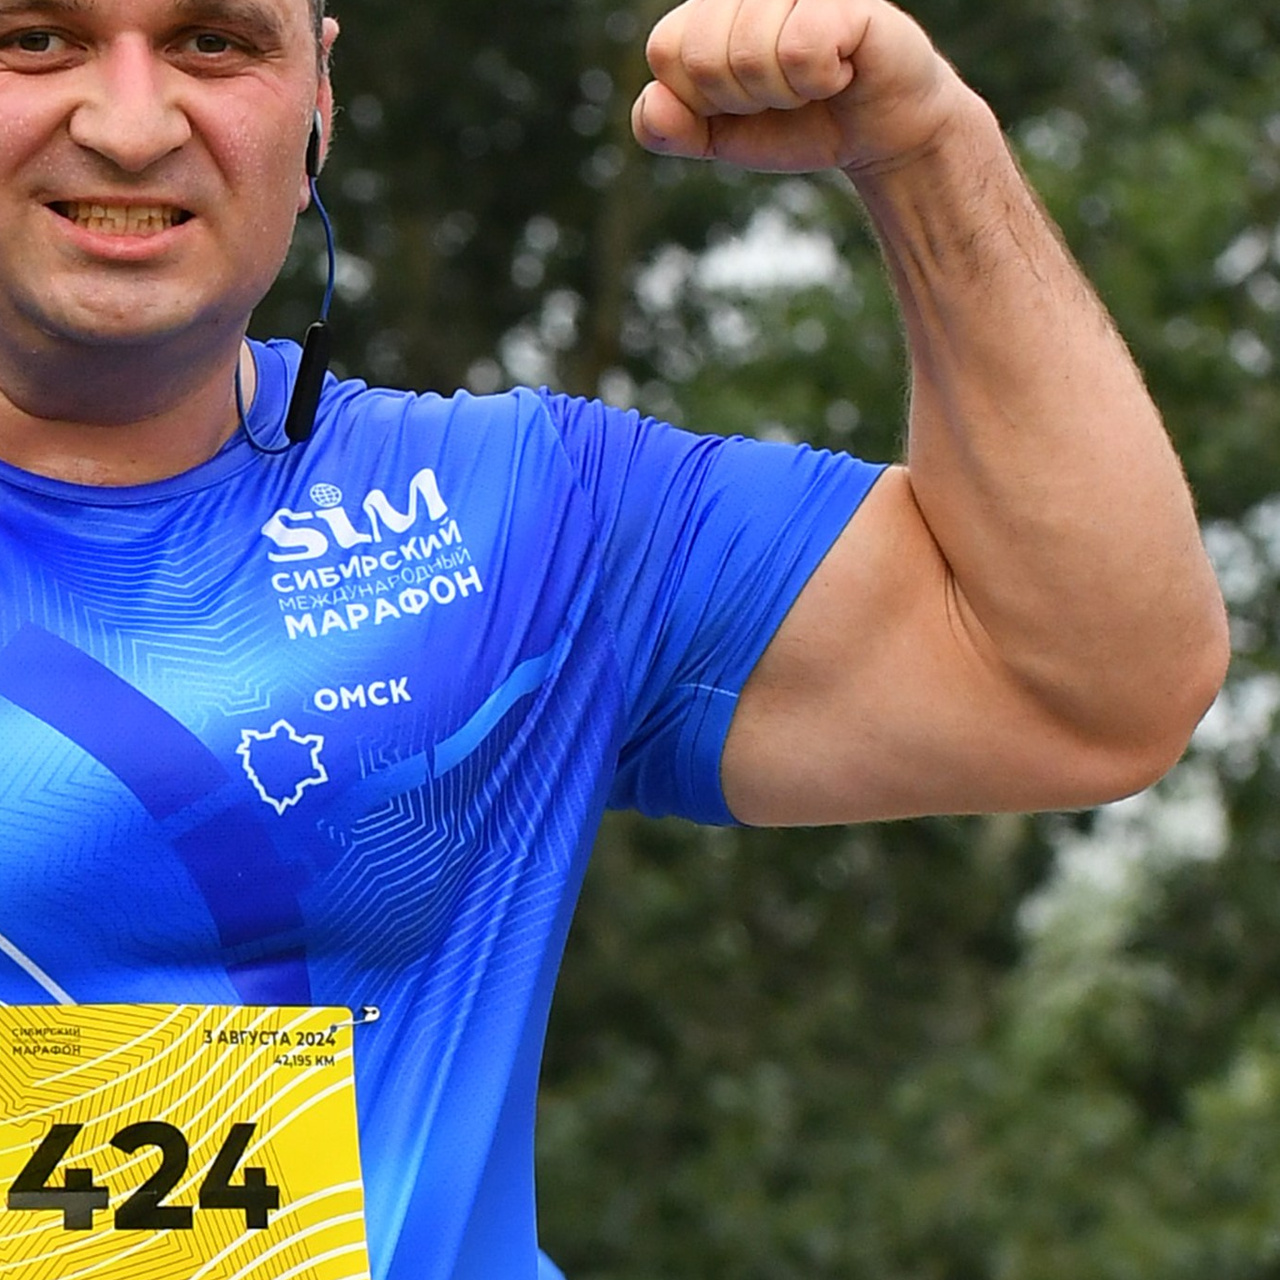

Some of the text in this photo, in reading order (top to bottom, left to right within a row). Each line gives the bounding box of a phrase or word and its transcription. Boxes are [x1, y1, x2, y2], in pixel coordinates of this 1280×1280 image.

[271, 517, 462, 593] СИБИРСКИЙ
[278, 547, 472, 612] МЕЖДУНАРОДНЫЙ
[284, 565, 483, 640] МАРАФОН
[314, 676, 412, 712] ОМСК
[11, 1044, 81, 1056] МАРАФОН
[204, 1029, 336, 1046] 3 АВГУСТА 2024
[274, 1054, 335, 1068] 42,195 КМ
[7, 1120, 280, 1231] 424
